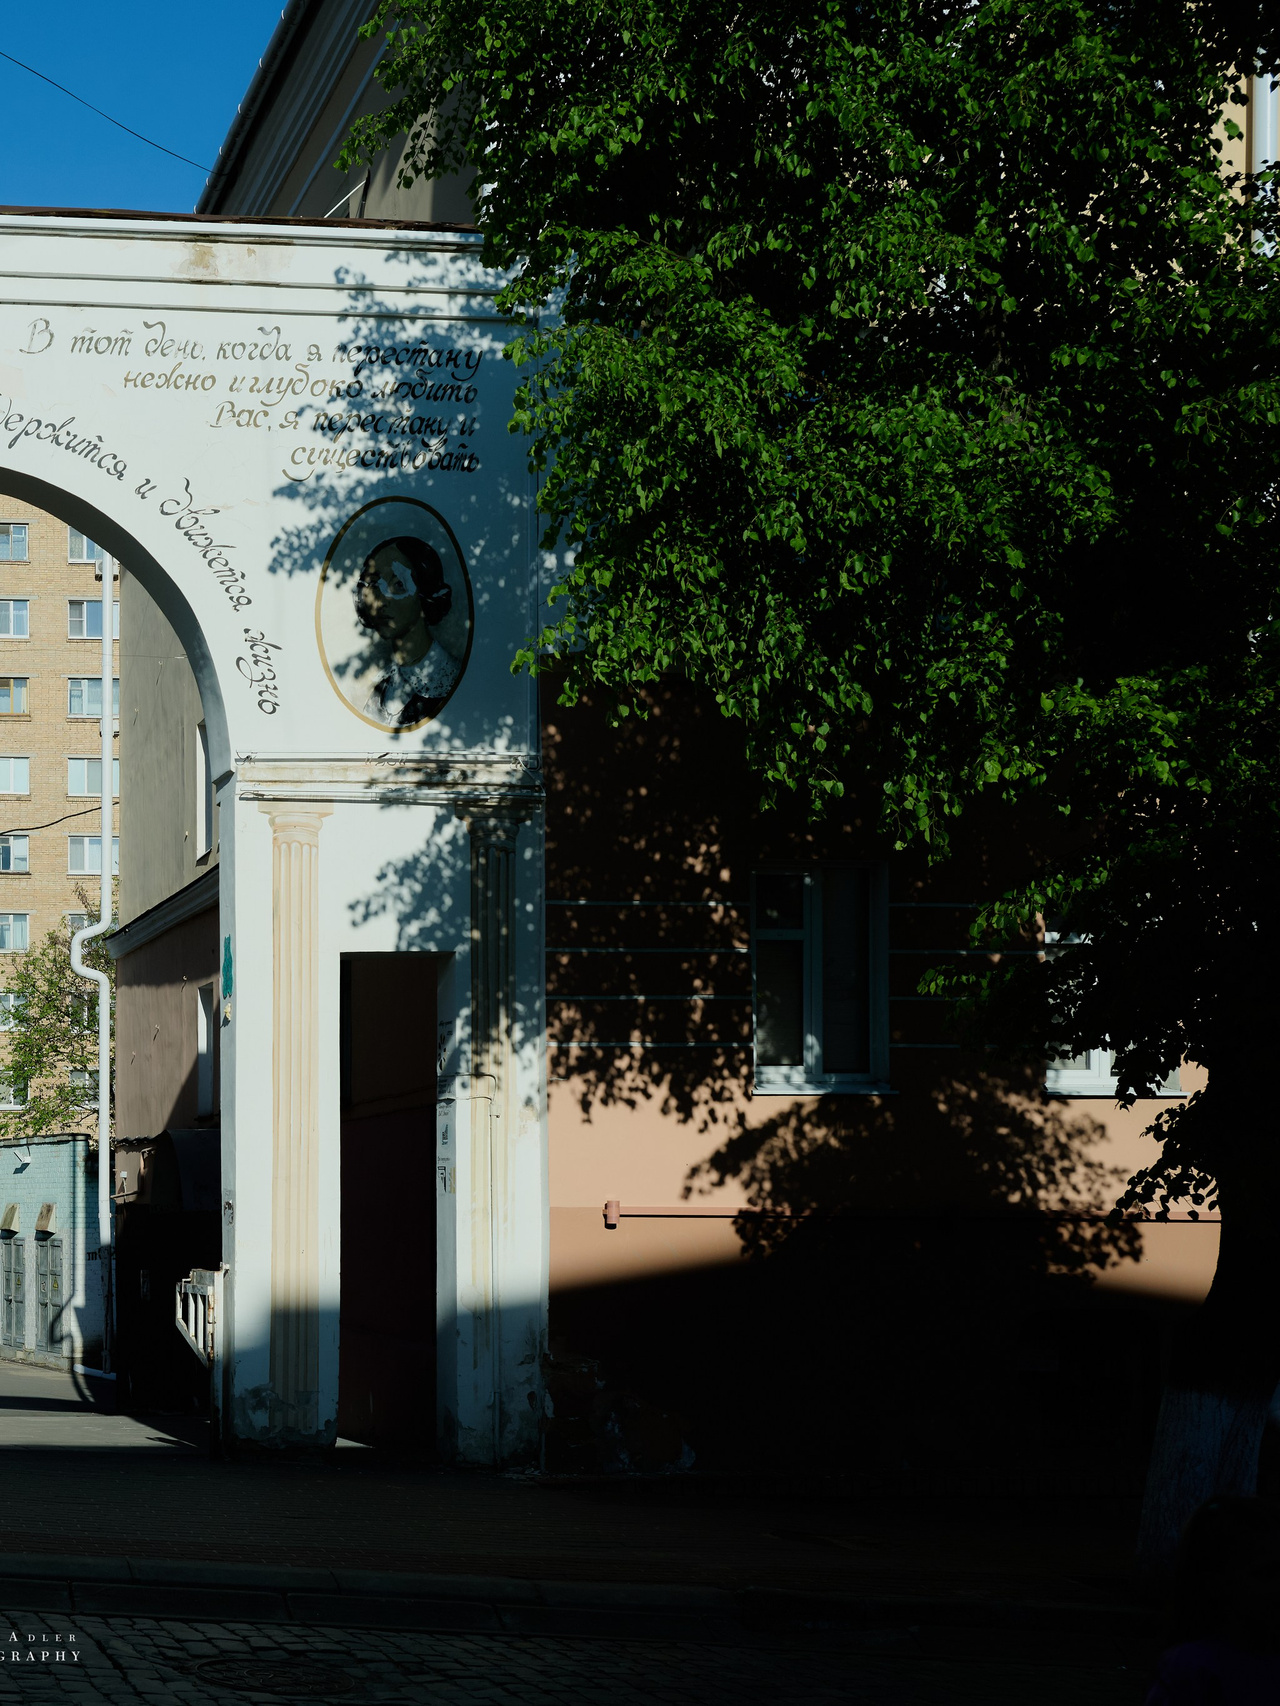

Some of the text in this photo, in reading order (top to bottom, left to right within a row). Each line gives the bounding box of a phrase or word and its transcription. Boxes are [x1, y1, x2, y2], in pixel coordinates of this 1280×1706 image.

[18, 317, 56, 355] В
[70, 326, 134, 357] тот
[215, 325, 293, 362] когда
[306, 343, 324, 363] я
[331, 340, 484, 382] перестану
[123, 361, 479, 407] нежно и глубоко любить
[208, 400, 477, 449] Вас, я перестану и
[281, 437, 482, 482] существовать
[134, 477, 158, 500] и
[158, 476, 253, 613] движется
[235, 627, 284, 716] жизнь
